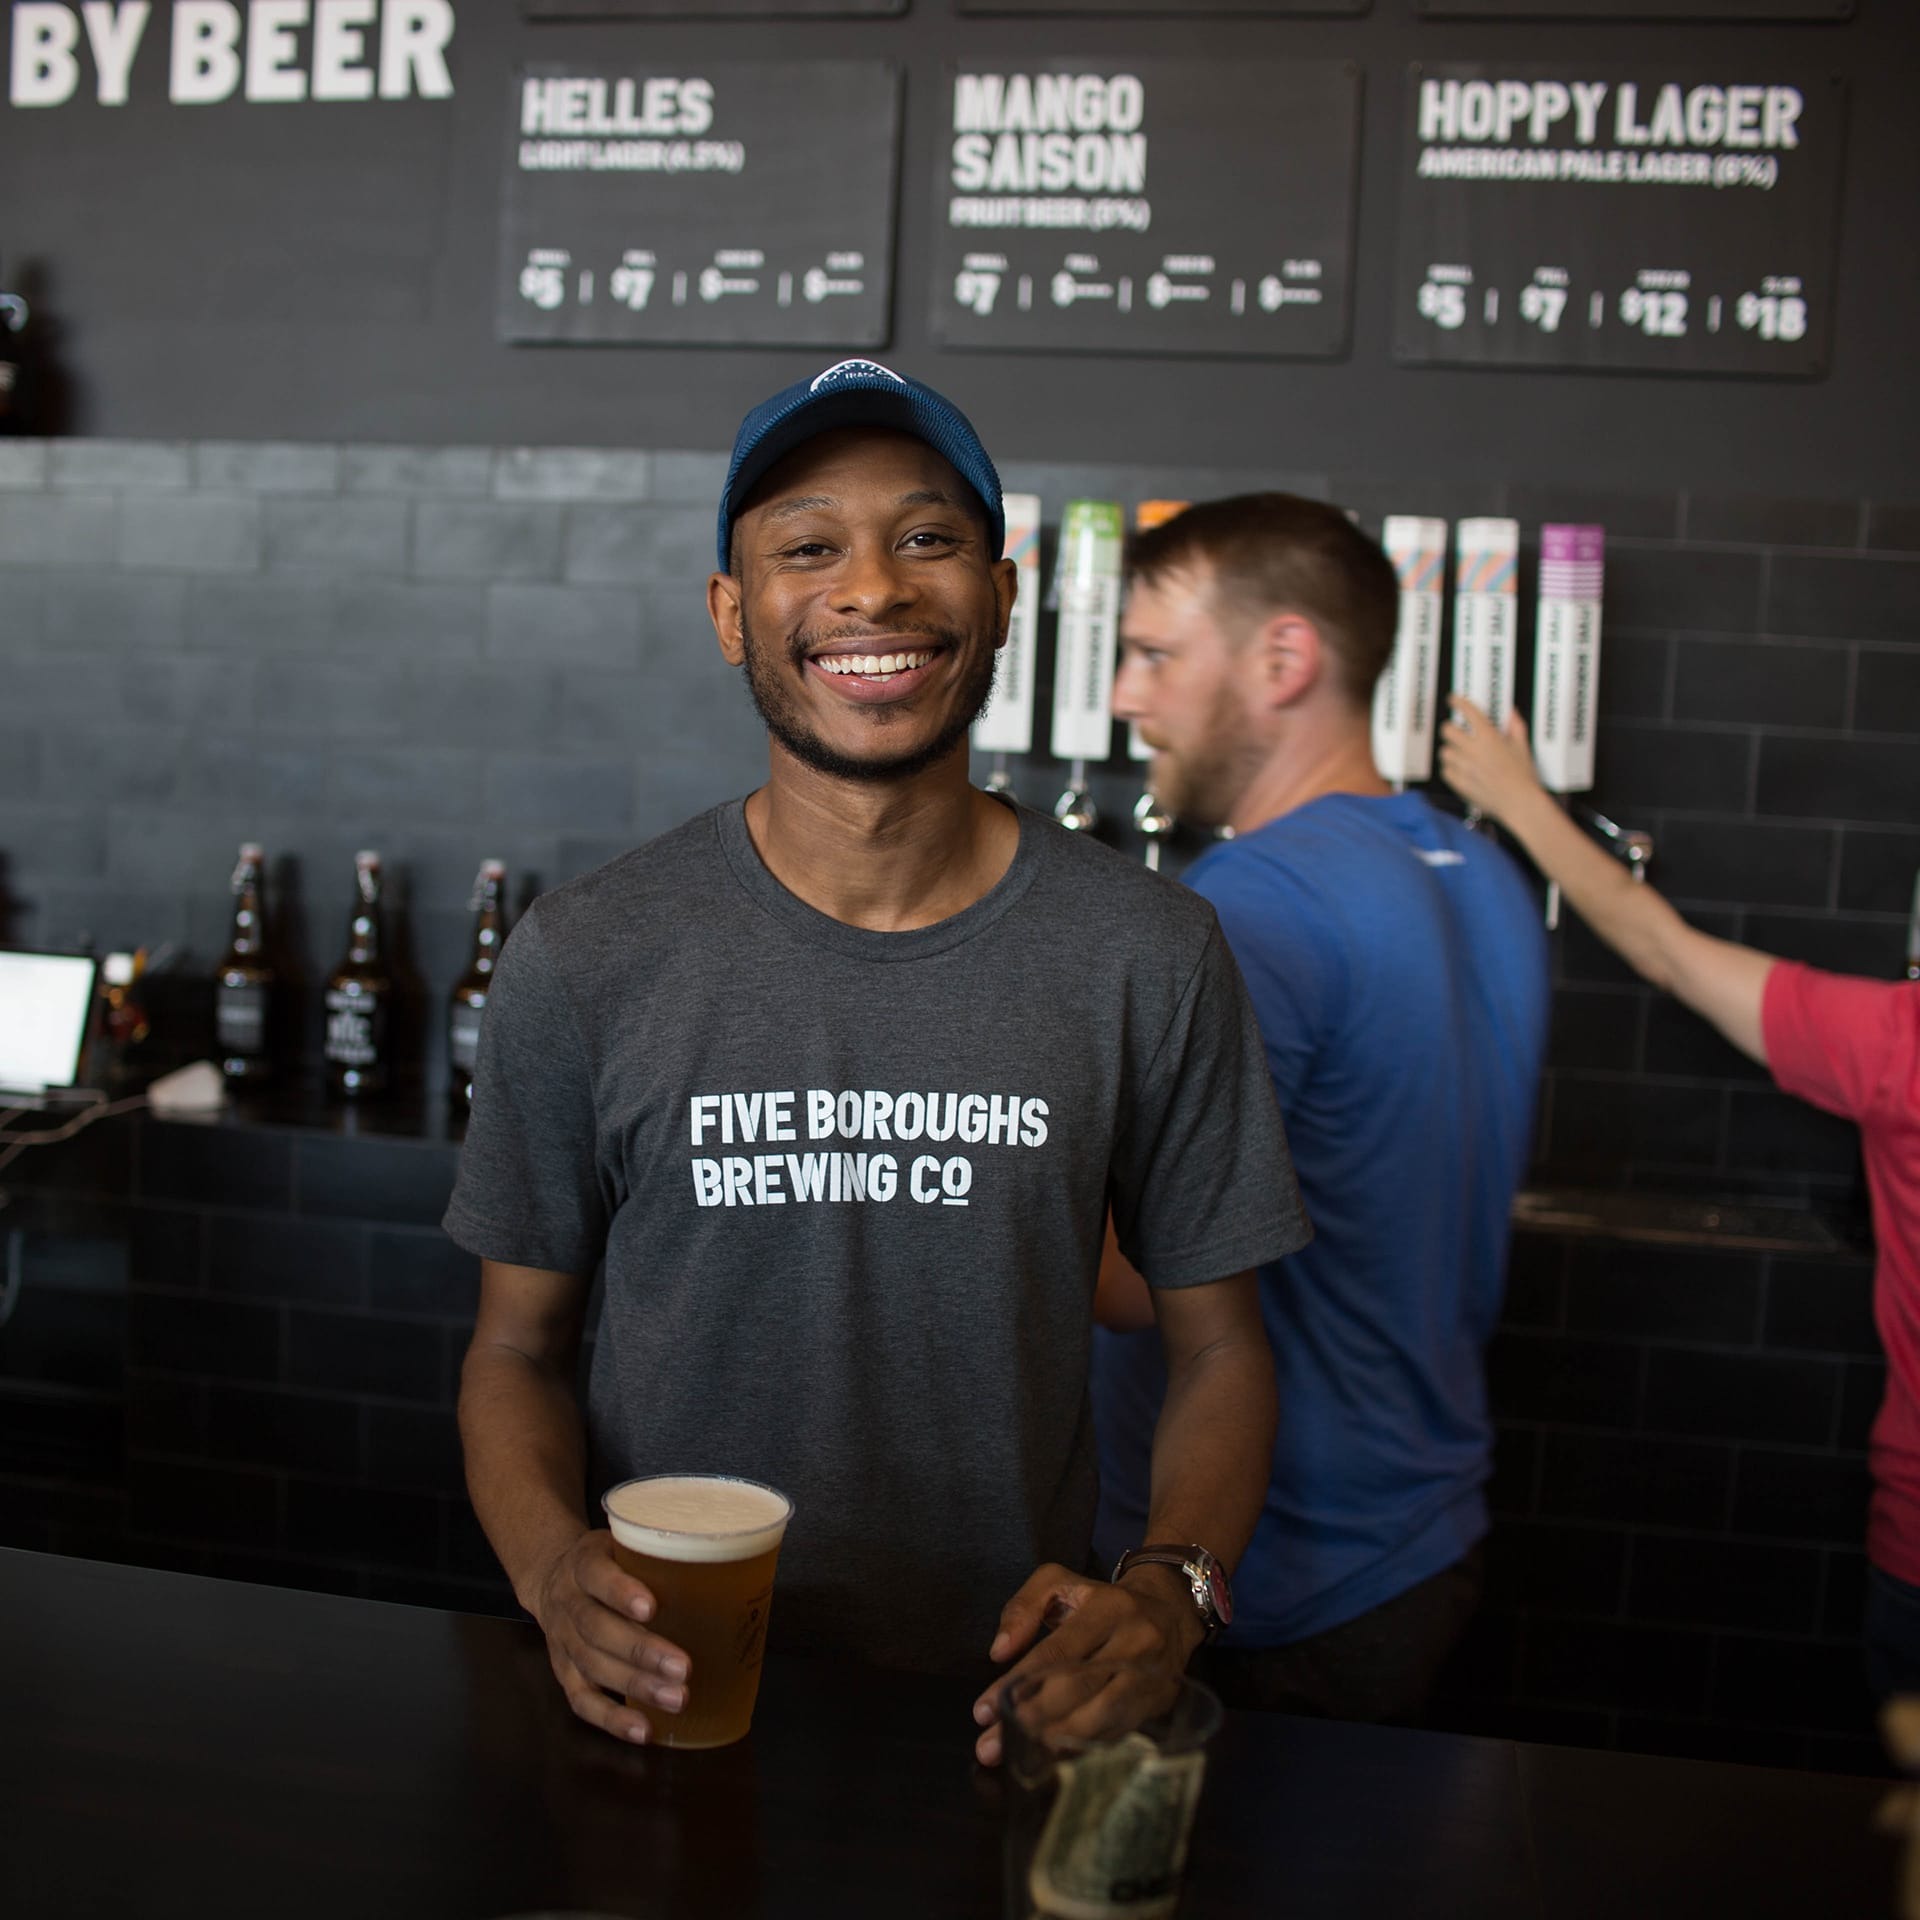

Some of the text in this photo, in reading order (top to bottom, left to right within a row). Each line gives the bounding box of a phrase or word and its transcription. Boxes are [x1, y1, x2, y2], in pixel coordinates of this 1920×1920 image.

[11, 0, 453, 106] BY BEER
[522, 79, 712, 134] HELLES
[954, 74, 1144, 131] MANGO
[1420, 81, 1801, 147] HOPPY LAGER
[953, 133, 1145, 190] SAISON
[1419, 149, 1556, 177] AMERICAN
[1559, 151, 1622, 180] PALE
[1624, 154, 1712, 182] LAGER
[521, 268, 562, 307] $5
[612, 269, 653, 308] $7
[957, 273, 999, 313] $7
[1420, 283, 1806, 340] $5 $7 $12 $18
[691, 1090, 1049, 1147] FIVE BOROUGHS
[692, 1153, 897, 1206] BREWING
